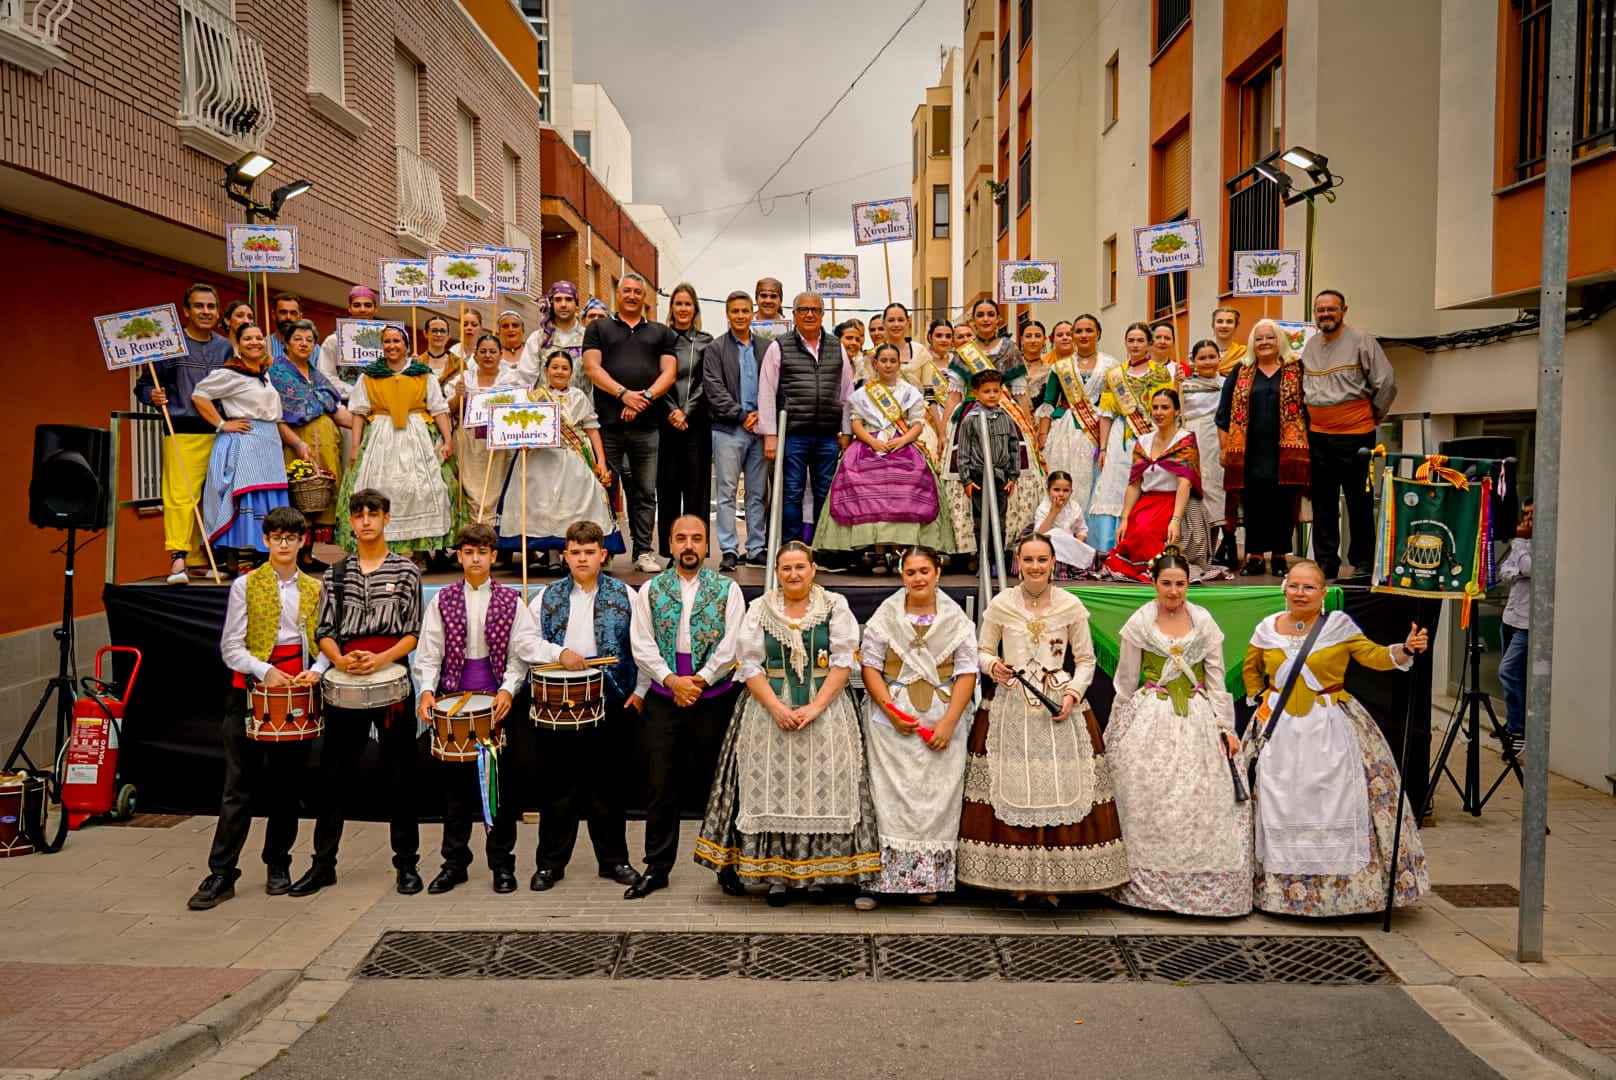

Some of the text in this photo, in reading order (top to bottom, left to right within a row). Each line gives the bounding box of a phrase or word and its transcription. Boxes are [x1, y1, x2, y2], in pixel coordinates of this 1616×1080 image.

[496, 274, 520, 285] uarts
[1246, 278, 1288, 289] Albufera
[389, 286, 428, 299] Torre Bell
[439, 279, 486, 294] Rodejo
[1011, 285, 1023, 297] El
[98, 740, 106, 765] POLVO
